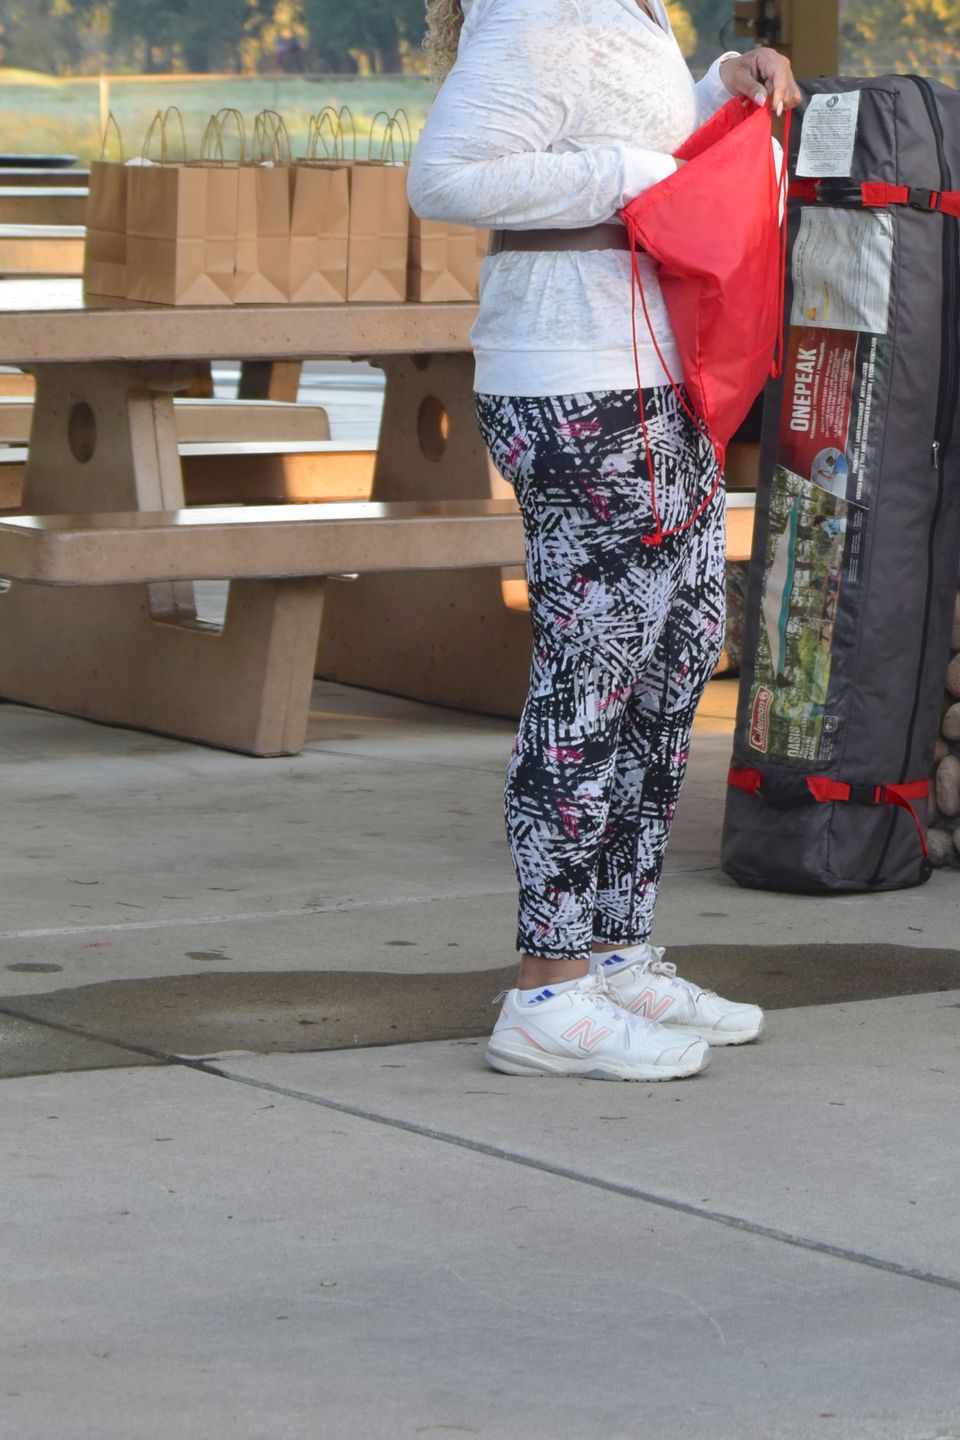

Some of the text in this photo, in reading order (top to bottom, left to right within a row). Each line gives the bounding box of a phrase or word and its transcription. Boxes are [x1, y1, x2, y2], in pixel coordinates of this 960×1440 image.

[789, 348, 816, 431] ONEPEAK
[751, 701, 765, 746] Coleman
[788, 726, 800, 757] OASIS
[560, 1016, 612, 1053] N
